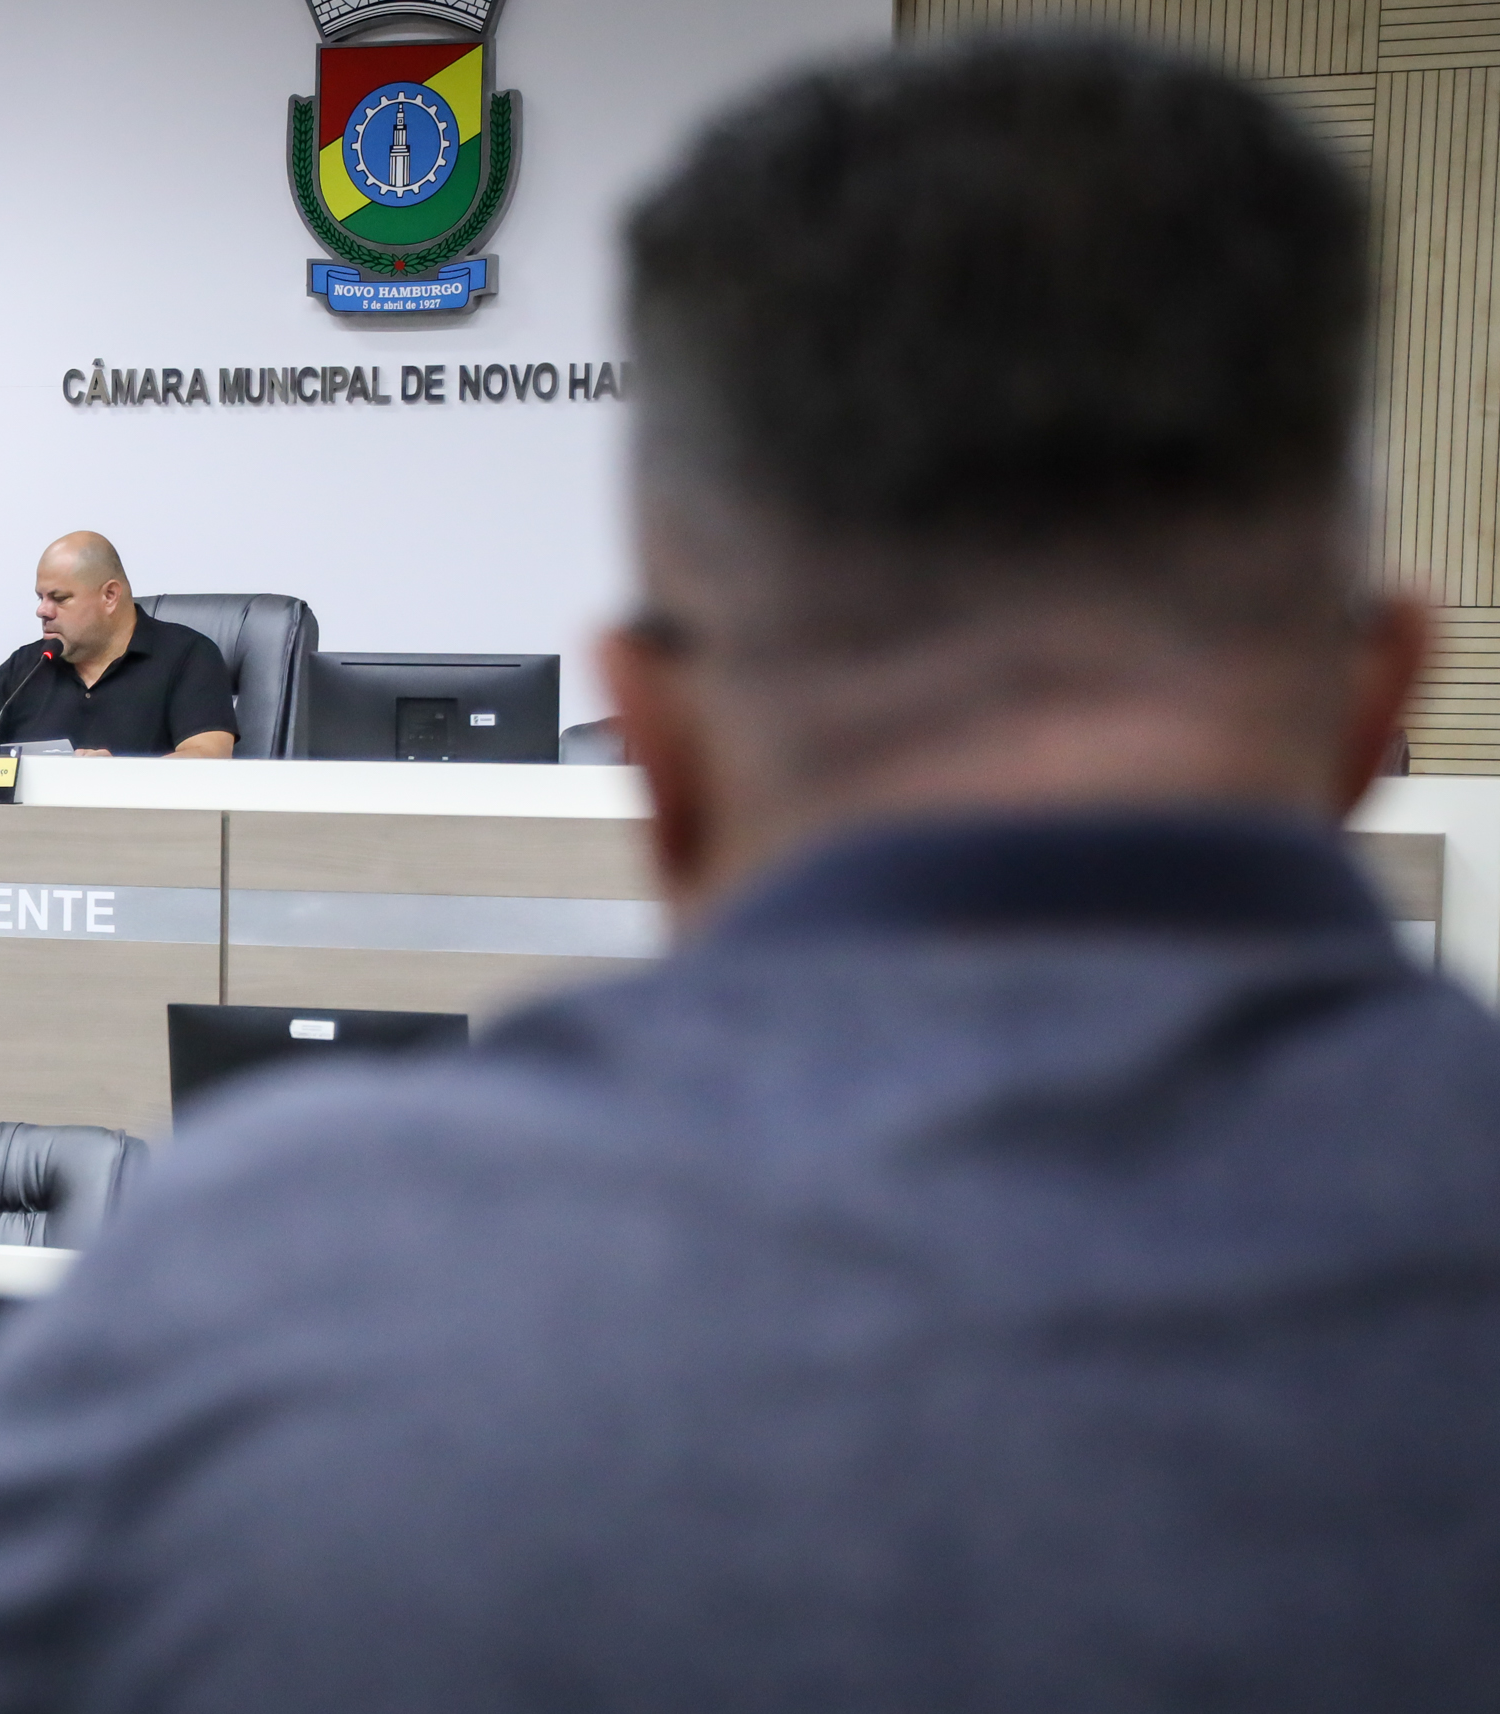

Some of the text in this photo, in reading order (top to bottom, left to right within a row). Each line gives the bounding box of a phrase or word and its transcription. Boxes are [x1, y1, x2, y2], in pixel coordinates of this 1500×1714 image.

[333, 282, 463, 299] NOVO HAMBURGO
[362, 299, 441, 310] 5 de abril de 1927
[62, 357, 211, 405] CÂMARA
[219, 366, 392, 405] MUNICIPAL
[401, 364, 446, 404] DE
[458, 363, 560, 402] NOVO
